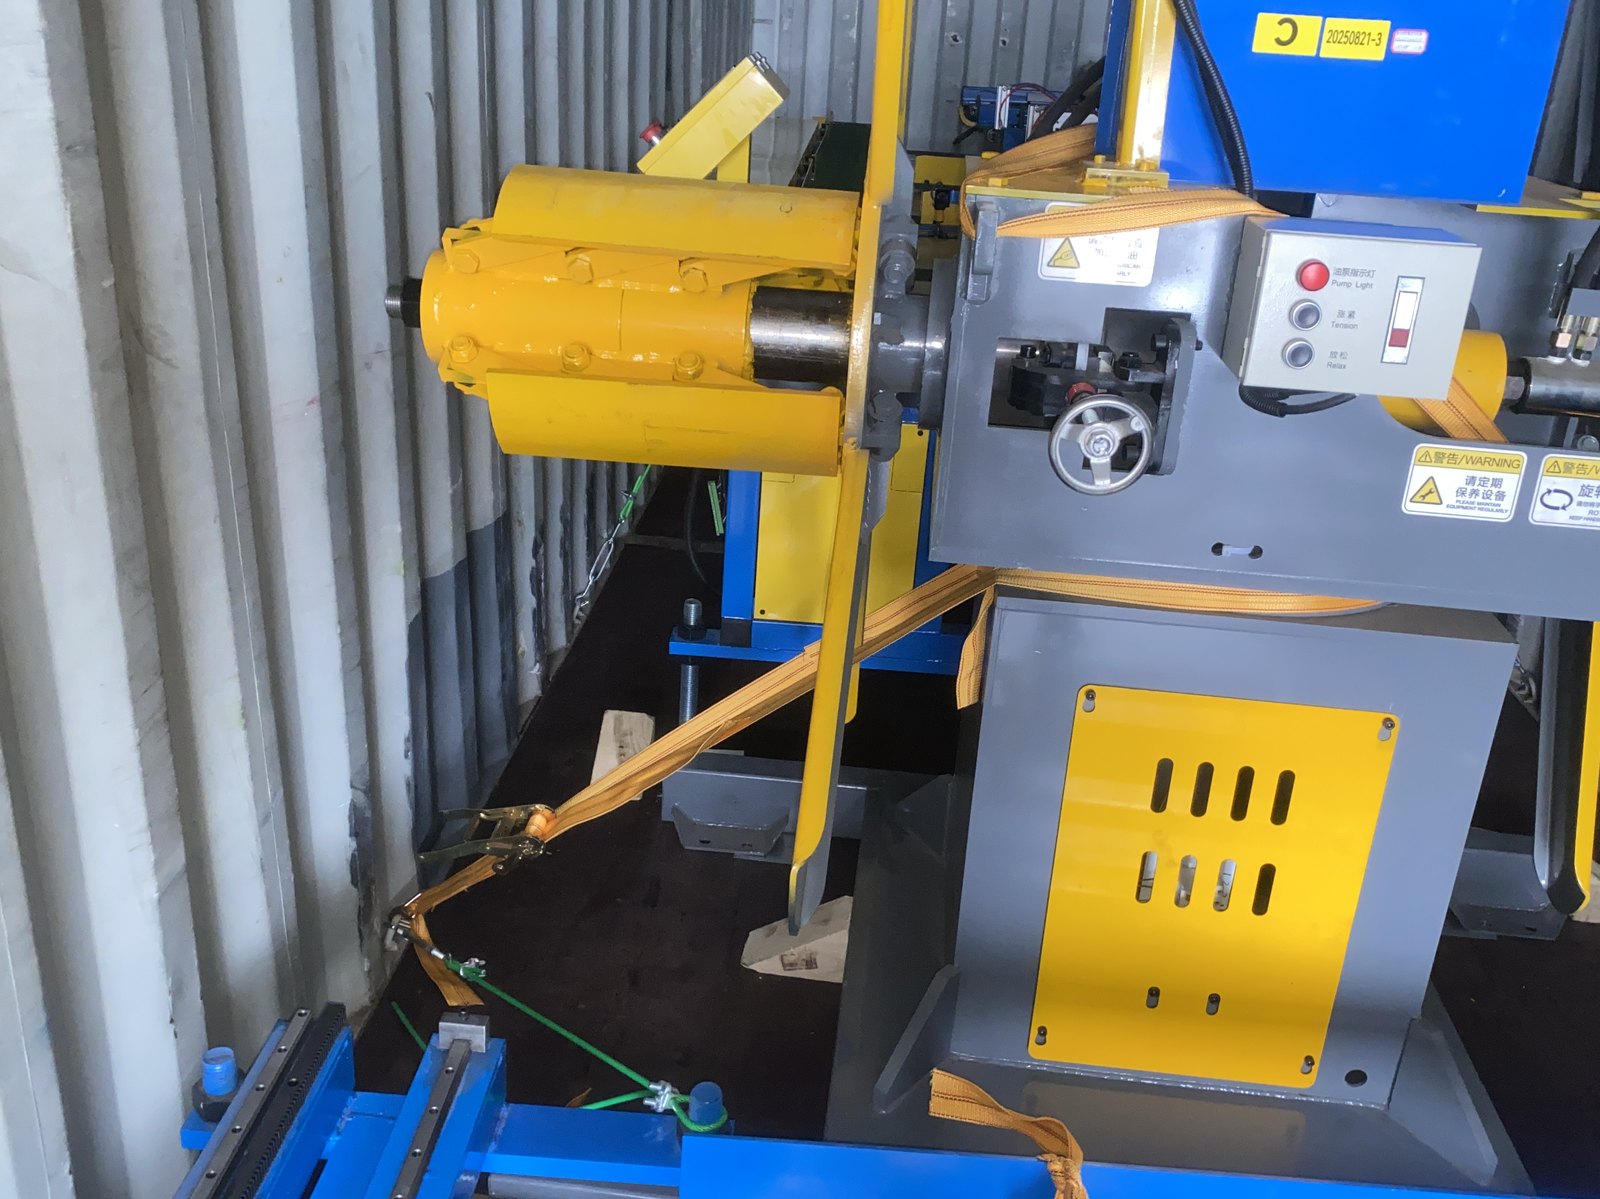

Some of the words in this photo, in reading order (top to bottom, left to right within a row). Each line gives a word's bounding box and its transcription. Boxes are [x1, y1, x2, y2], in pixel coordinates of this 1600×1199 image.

[1326, 29, 1382, 46] 20250821-3
[1331, 280, 1352, 288] Pump
[1355, 281, 1373, 290] Light
[1331, 320, 1358, 329] Tension
[1327, 361, 1346, 369] Relax
[1433, 451, 1521, 469] 警告/WARNING
[1465, 475, 1503, 489] 请定期
[1456, 487, 1506, 501] 保养设备
